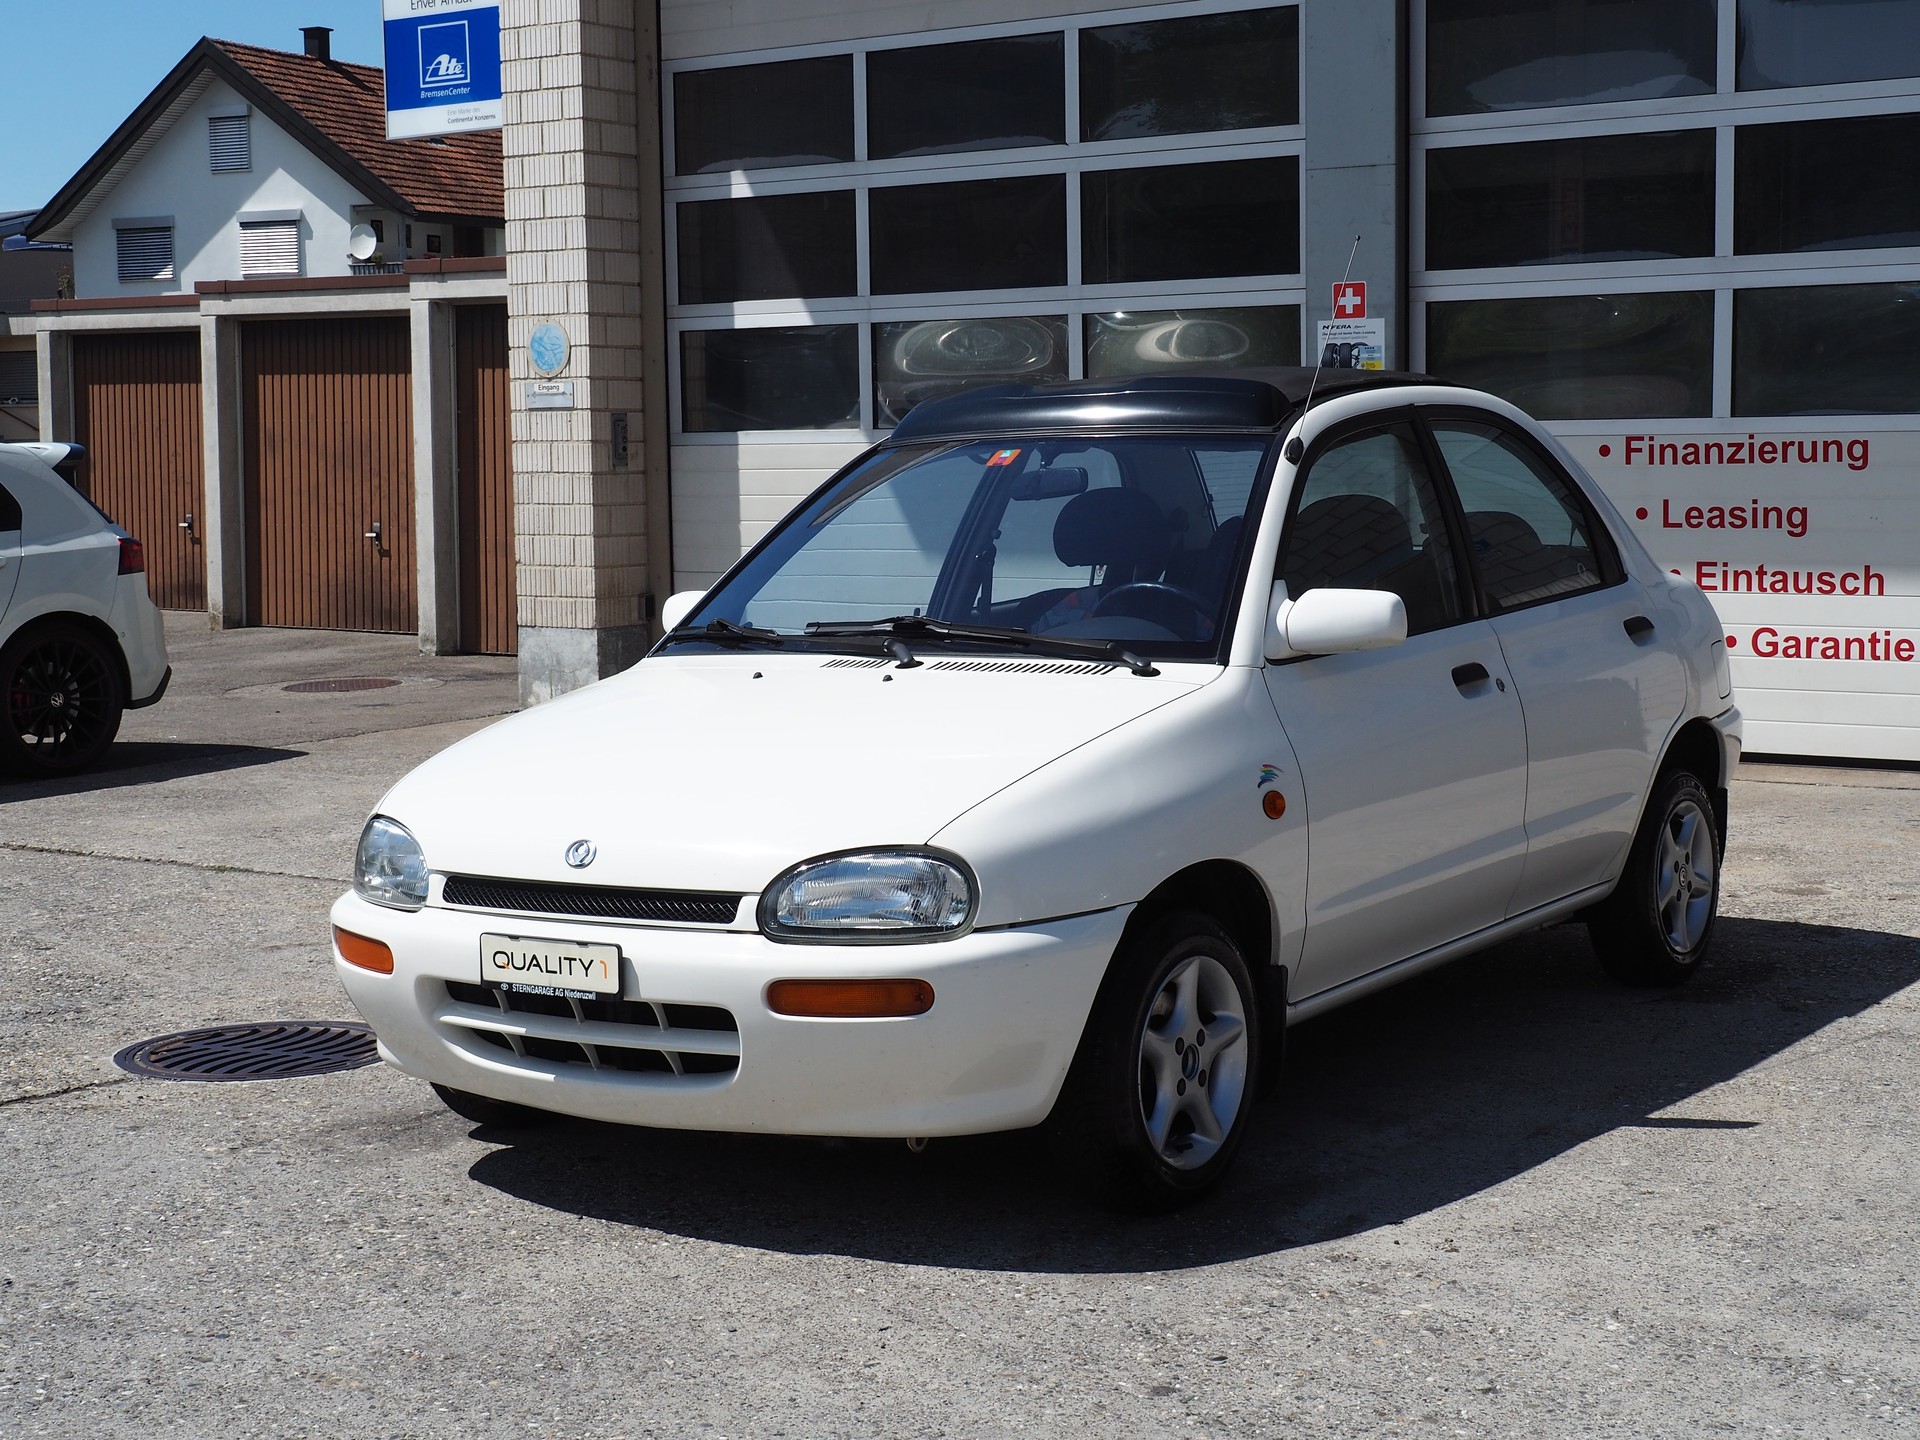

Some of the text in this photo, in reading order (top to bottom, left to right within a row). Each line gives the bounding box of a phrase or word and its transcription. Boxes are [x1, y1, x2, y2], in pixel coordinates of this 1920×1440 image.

[425, 53, 464, 82] Ate
[420, 87, 470, 98] BremsenCenter
[447, 115, 473, 124] Continental
[1624, 433, 1869, 471] Finanzierung
[1662, 498, 1808, 537] Leasing
[1695, 561, 1885, 596] Eintausch
[1750, 626, 1915, 662] Garantie
[492, 950, 608, 979] QUALITY 1
[512, 983, 597, 1001] STERNGARAGE AG Niederuzwil
